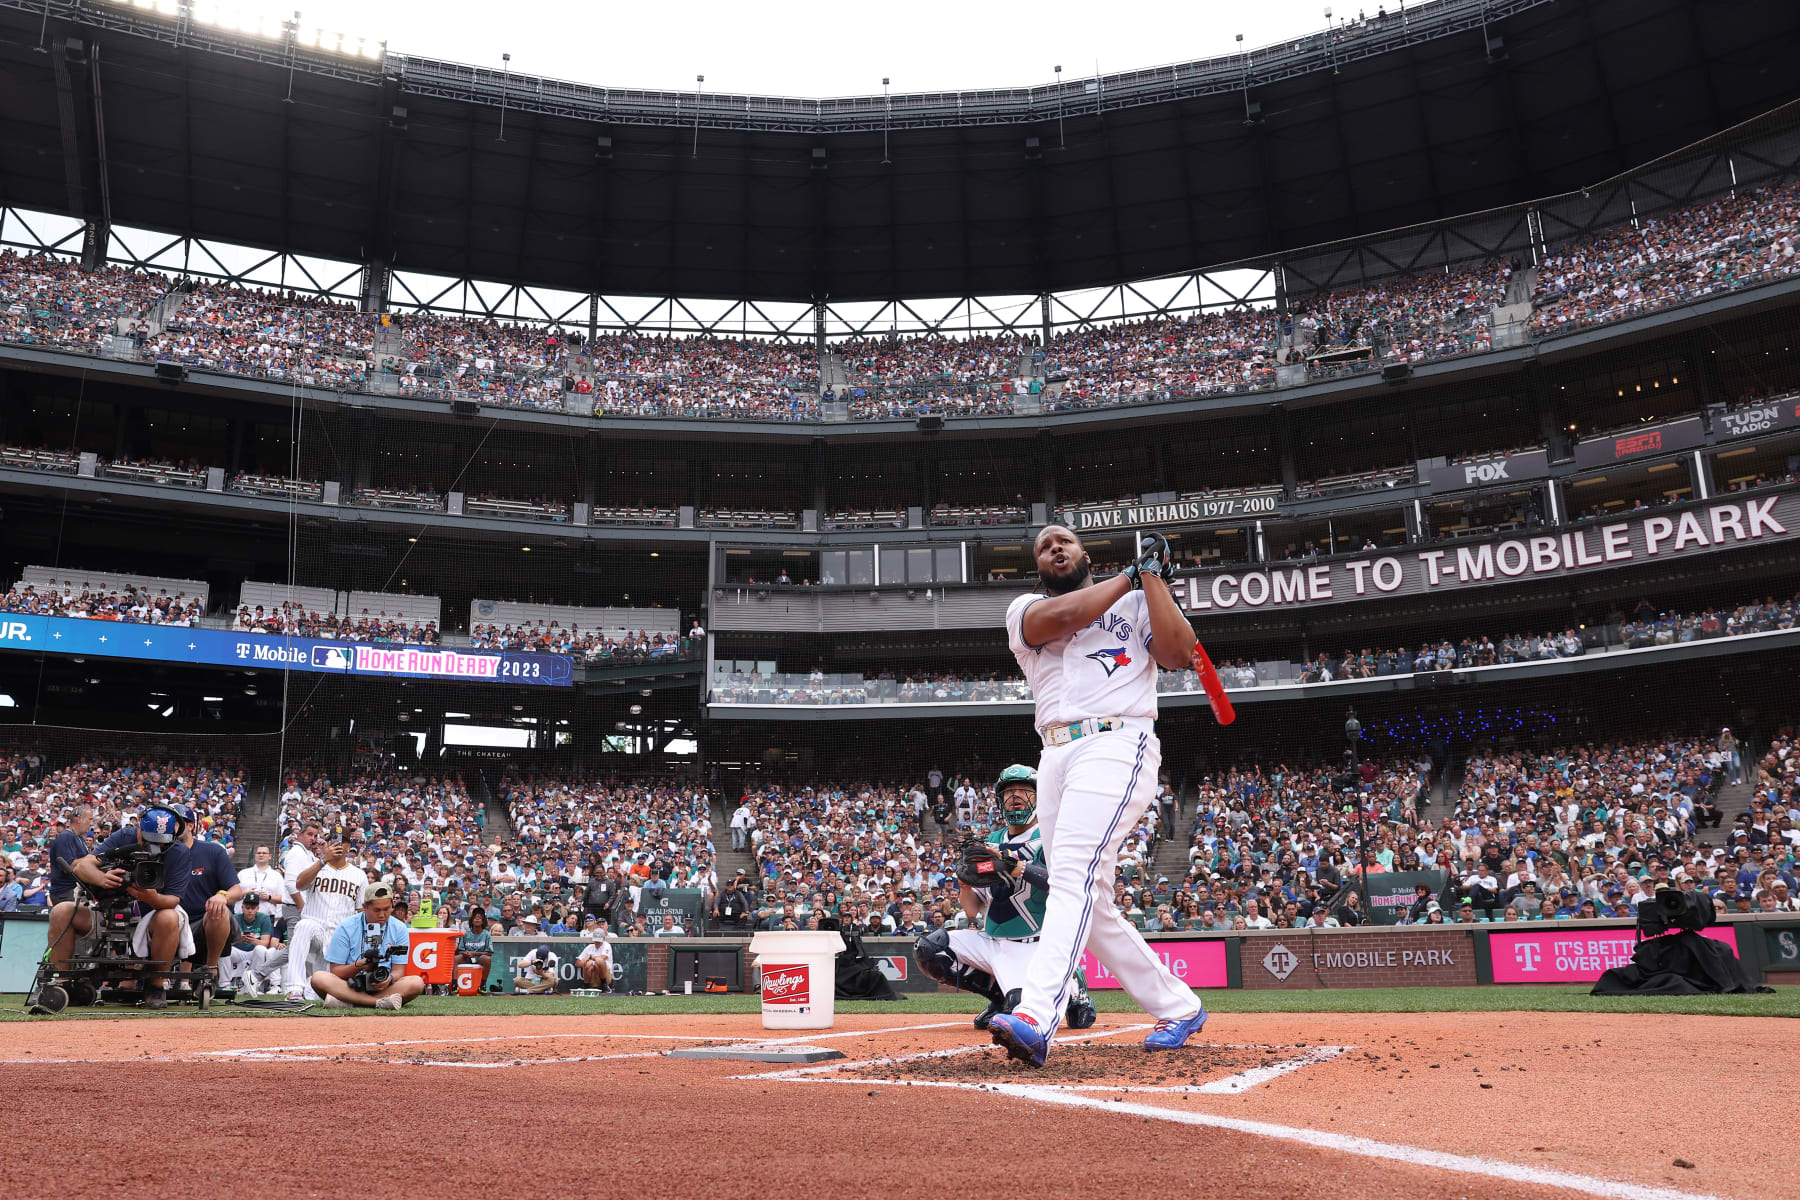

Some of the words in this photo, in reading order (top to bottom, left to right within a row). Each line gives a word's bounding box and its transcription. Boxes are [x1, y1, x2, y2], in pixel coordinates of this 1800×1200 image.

[1721, 406, 1779, 428] TUDN
[1732, 421, 1771, 436] RADIO
[1615, 431, 1661, 450] ESPN
[1464, 460, 1509, 484] FOX
[1081, 509, 1123, 528] DAVE
[1128, 502, 1199, 525] NIEHAUS
[1172, 564, 1333, 611] ELCOME
[1346, 556, 1403, 595] TO
[1418, 523, 1634, 586] T-MOBILE
[1643, 496, 1788, 555] PARK
[1090, 613, 1133, 641] AYS
[253, 644, 307, 663] Mobile
[445, 653, 500, 676] DERBY
[502, 661, 540, 677] 2023
[313, 876, 360, 901] PADRES
[412, 941, 438, 970] G
[1311, 951, 1397, 969] T-MOBILE
[1402, 949, 1454, 966] PARK
[1554, 941, 1584, 956] IT'S
[1556, 956, 1601, 971] OVER
[457, 973, 473, 990] G
[763, 973, 805, 991] Rawlings
